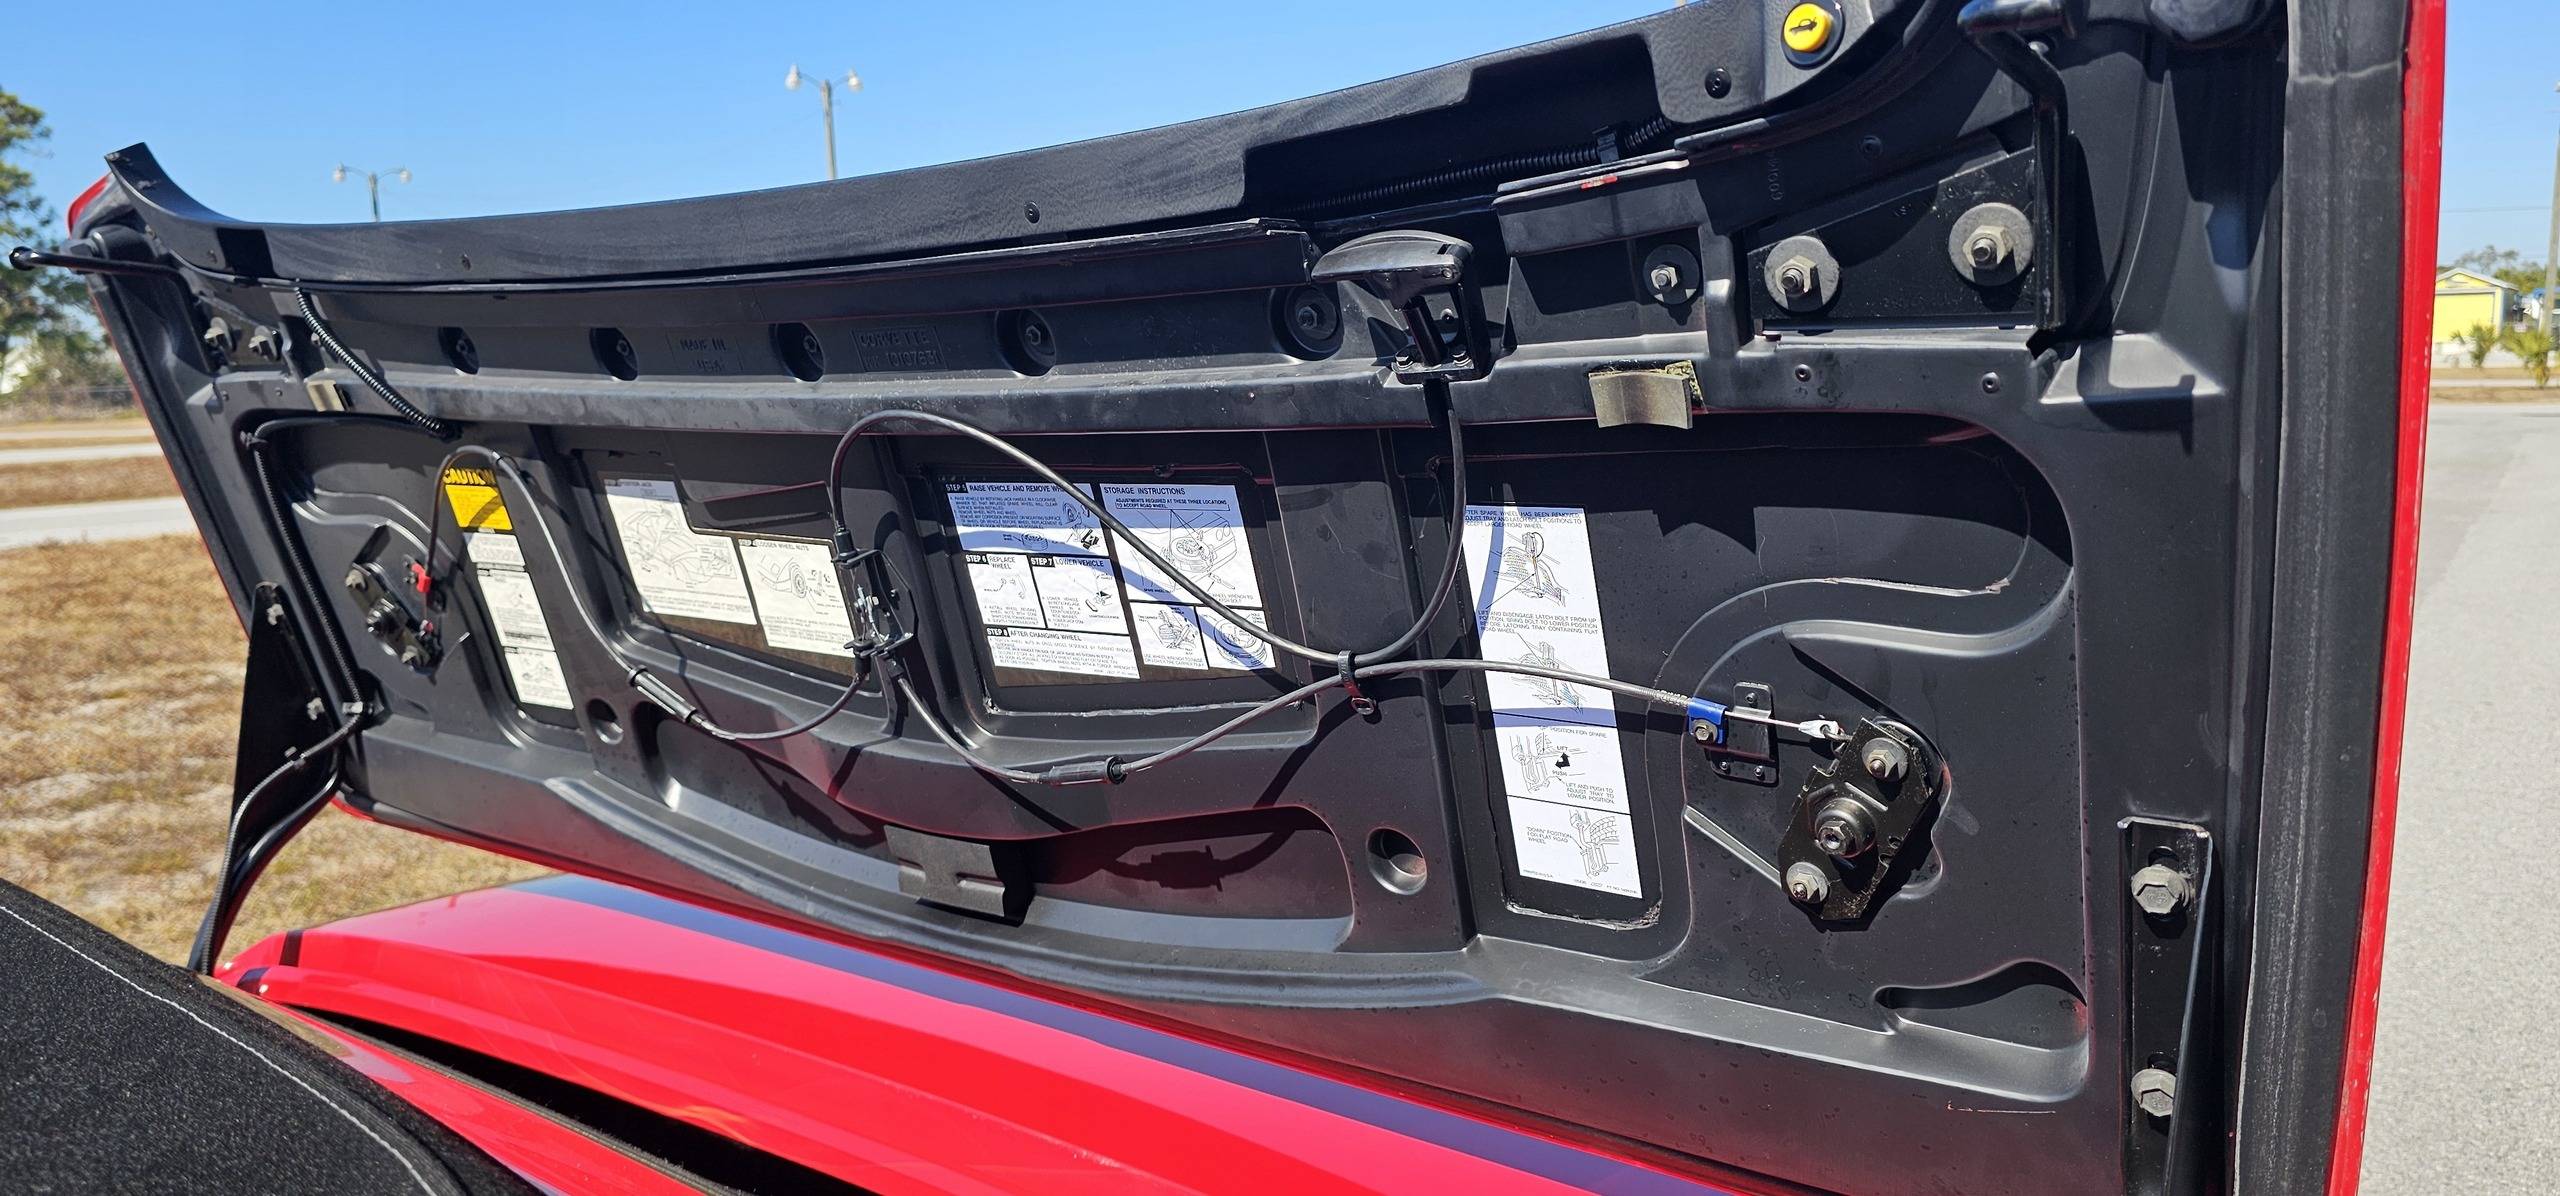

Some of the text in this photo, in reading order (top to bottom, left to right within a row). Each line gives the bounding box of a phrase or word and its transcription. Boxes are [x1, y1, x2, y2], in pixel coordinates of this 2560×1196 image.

[443, 467, 496, 485] CAUTION
[945, 483, 960, 492] STEP
[970, 484, 986, 492] RAISE
[986, 484, 1011, 492] VEHICLE
[1103, 486, 1186, 496] STORAGE INSTRUCTIONS
[966, 554, 981, 562] STEP
[1031, 557, 1105, 567] STEP 7 LOWER VEHICLE
[1502, 611, 1534, 619] DISENGAGE
[1503, 622, 1530, 630] LATCHING
[1547, 625, 1583, 634] CONTAINING
[987, 627, 1003, 636] STEP
[1010, 630, 1028, 638] AFTER
[1029, 631, 1060, 640] CHANGING
[1061, 633, 1082, 641] WHEEL
[1552, 769, 1568, 777] PUSH
[1566, 787, 1587, 795] ADJUST
[1547, 829, 1570, 838] POSITION
[1528, 836, 1546, 845] WHEEL
